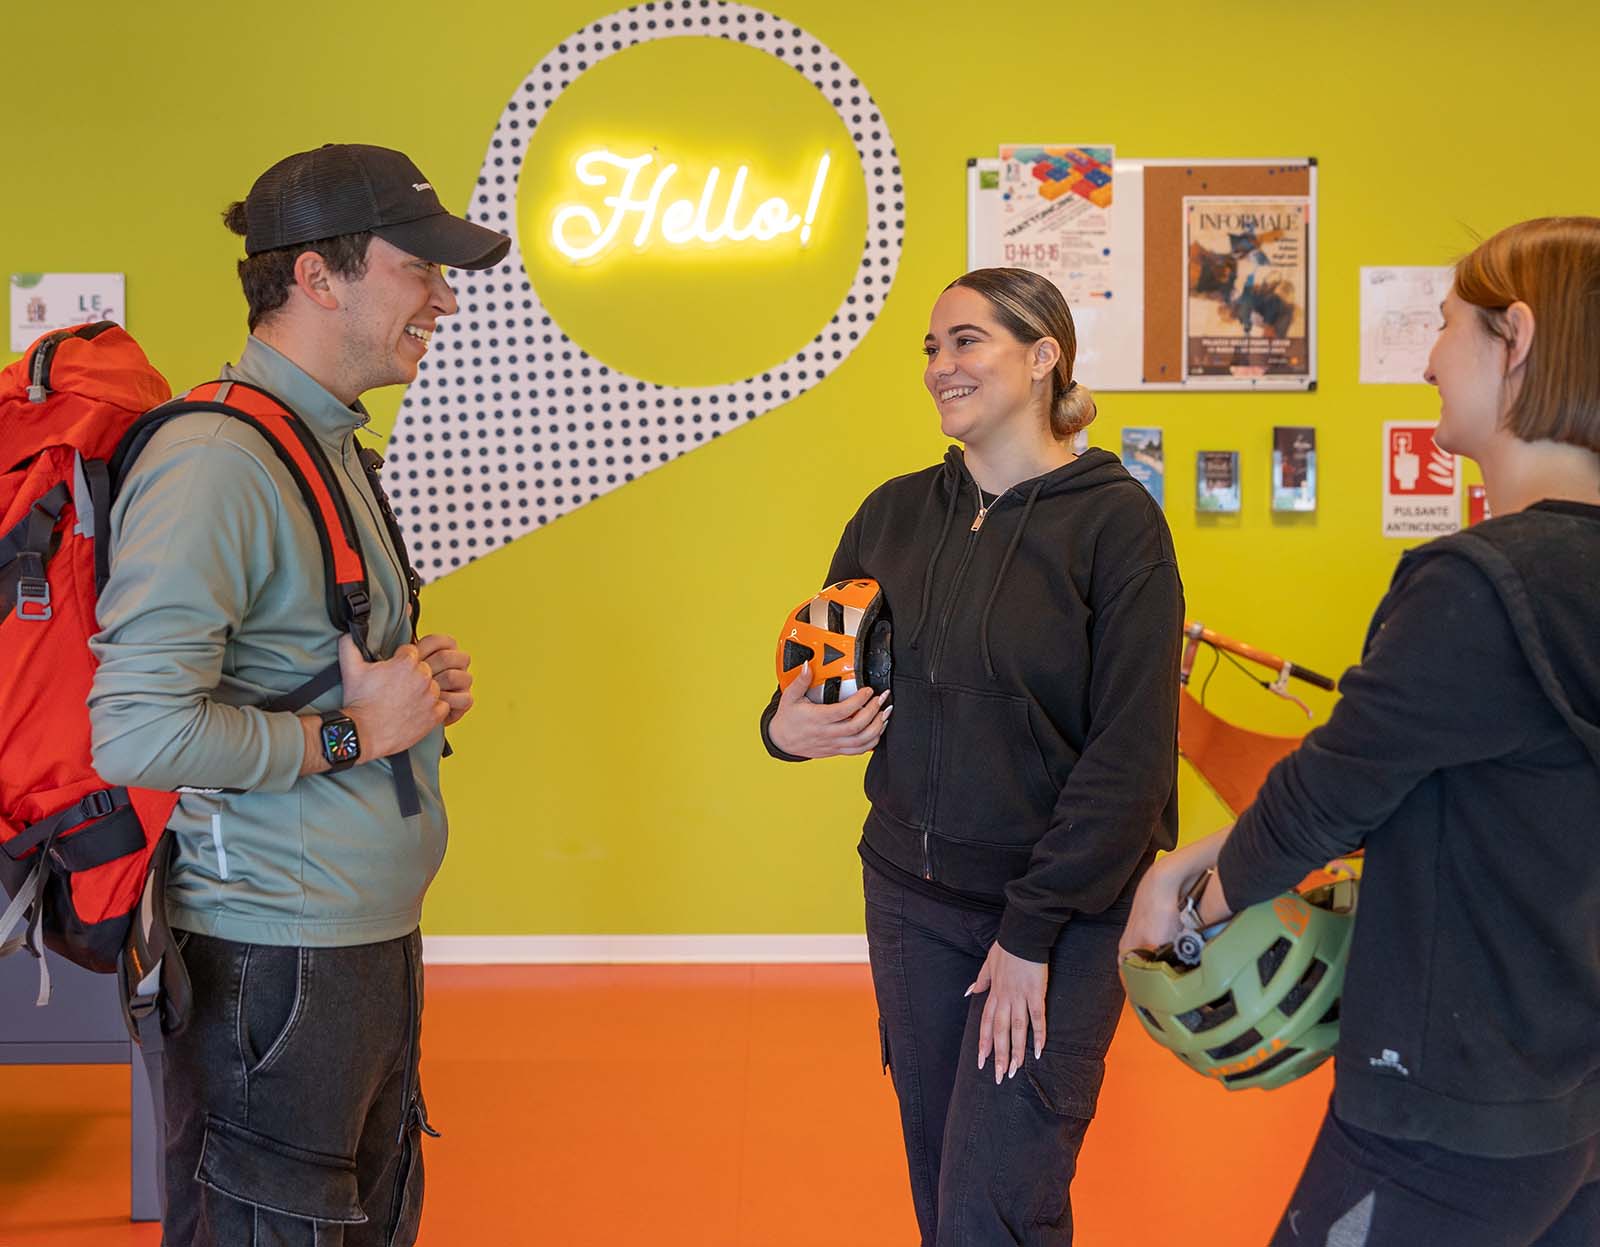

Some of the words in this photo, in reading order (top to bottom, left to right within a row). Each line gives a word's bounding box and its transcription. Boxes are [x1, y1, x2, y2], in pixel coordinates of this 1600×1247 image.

[551, 149, 831, 261] Hello!
[1200, 213, 1299, 231] INFORMALE
[1393, 505, 1449, 518] PULSANTE
[1386, 521, 1458, 533] ANTINCENDIO
